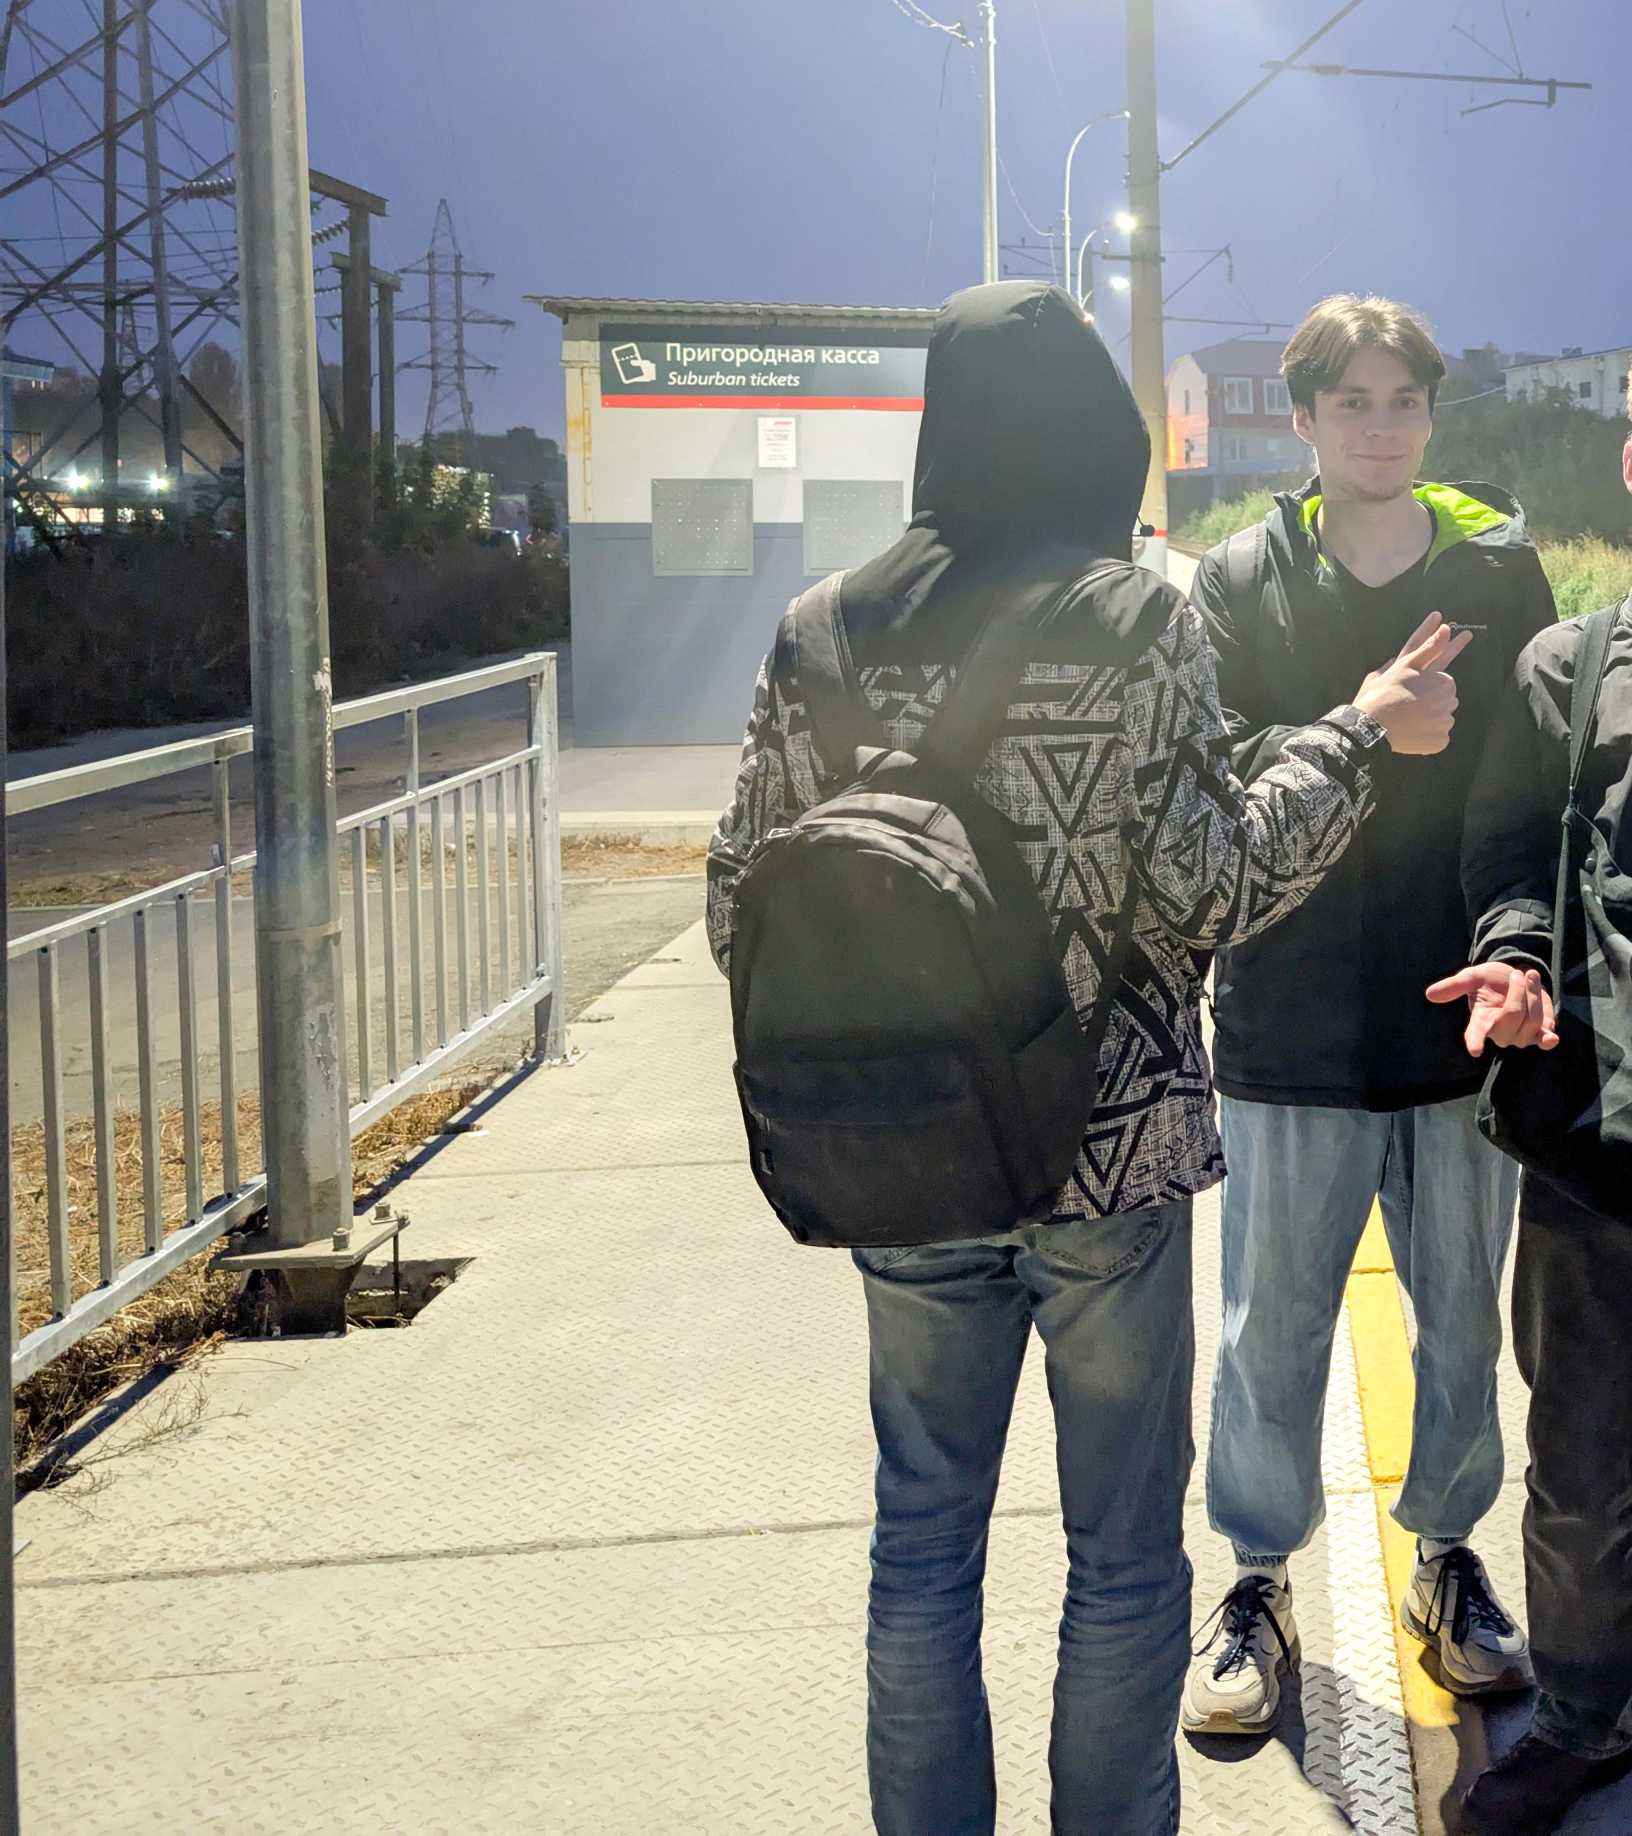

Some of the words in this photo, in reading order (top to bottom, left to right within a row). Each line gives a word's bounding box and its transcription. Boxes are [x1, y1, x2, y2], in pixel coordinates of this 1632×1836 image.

[666, 343, 815, 367] Пригородная
[821, 349, 880, 364] касса
[667, 371, 746, 386] Suburban
[750, 371, 800, 386] tickets
